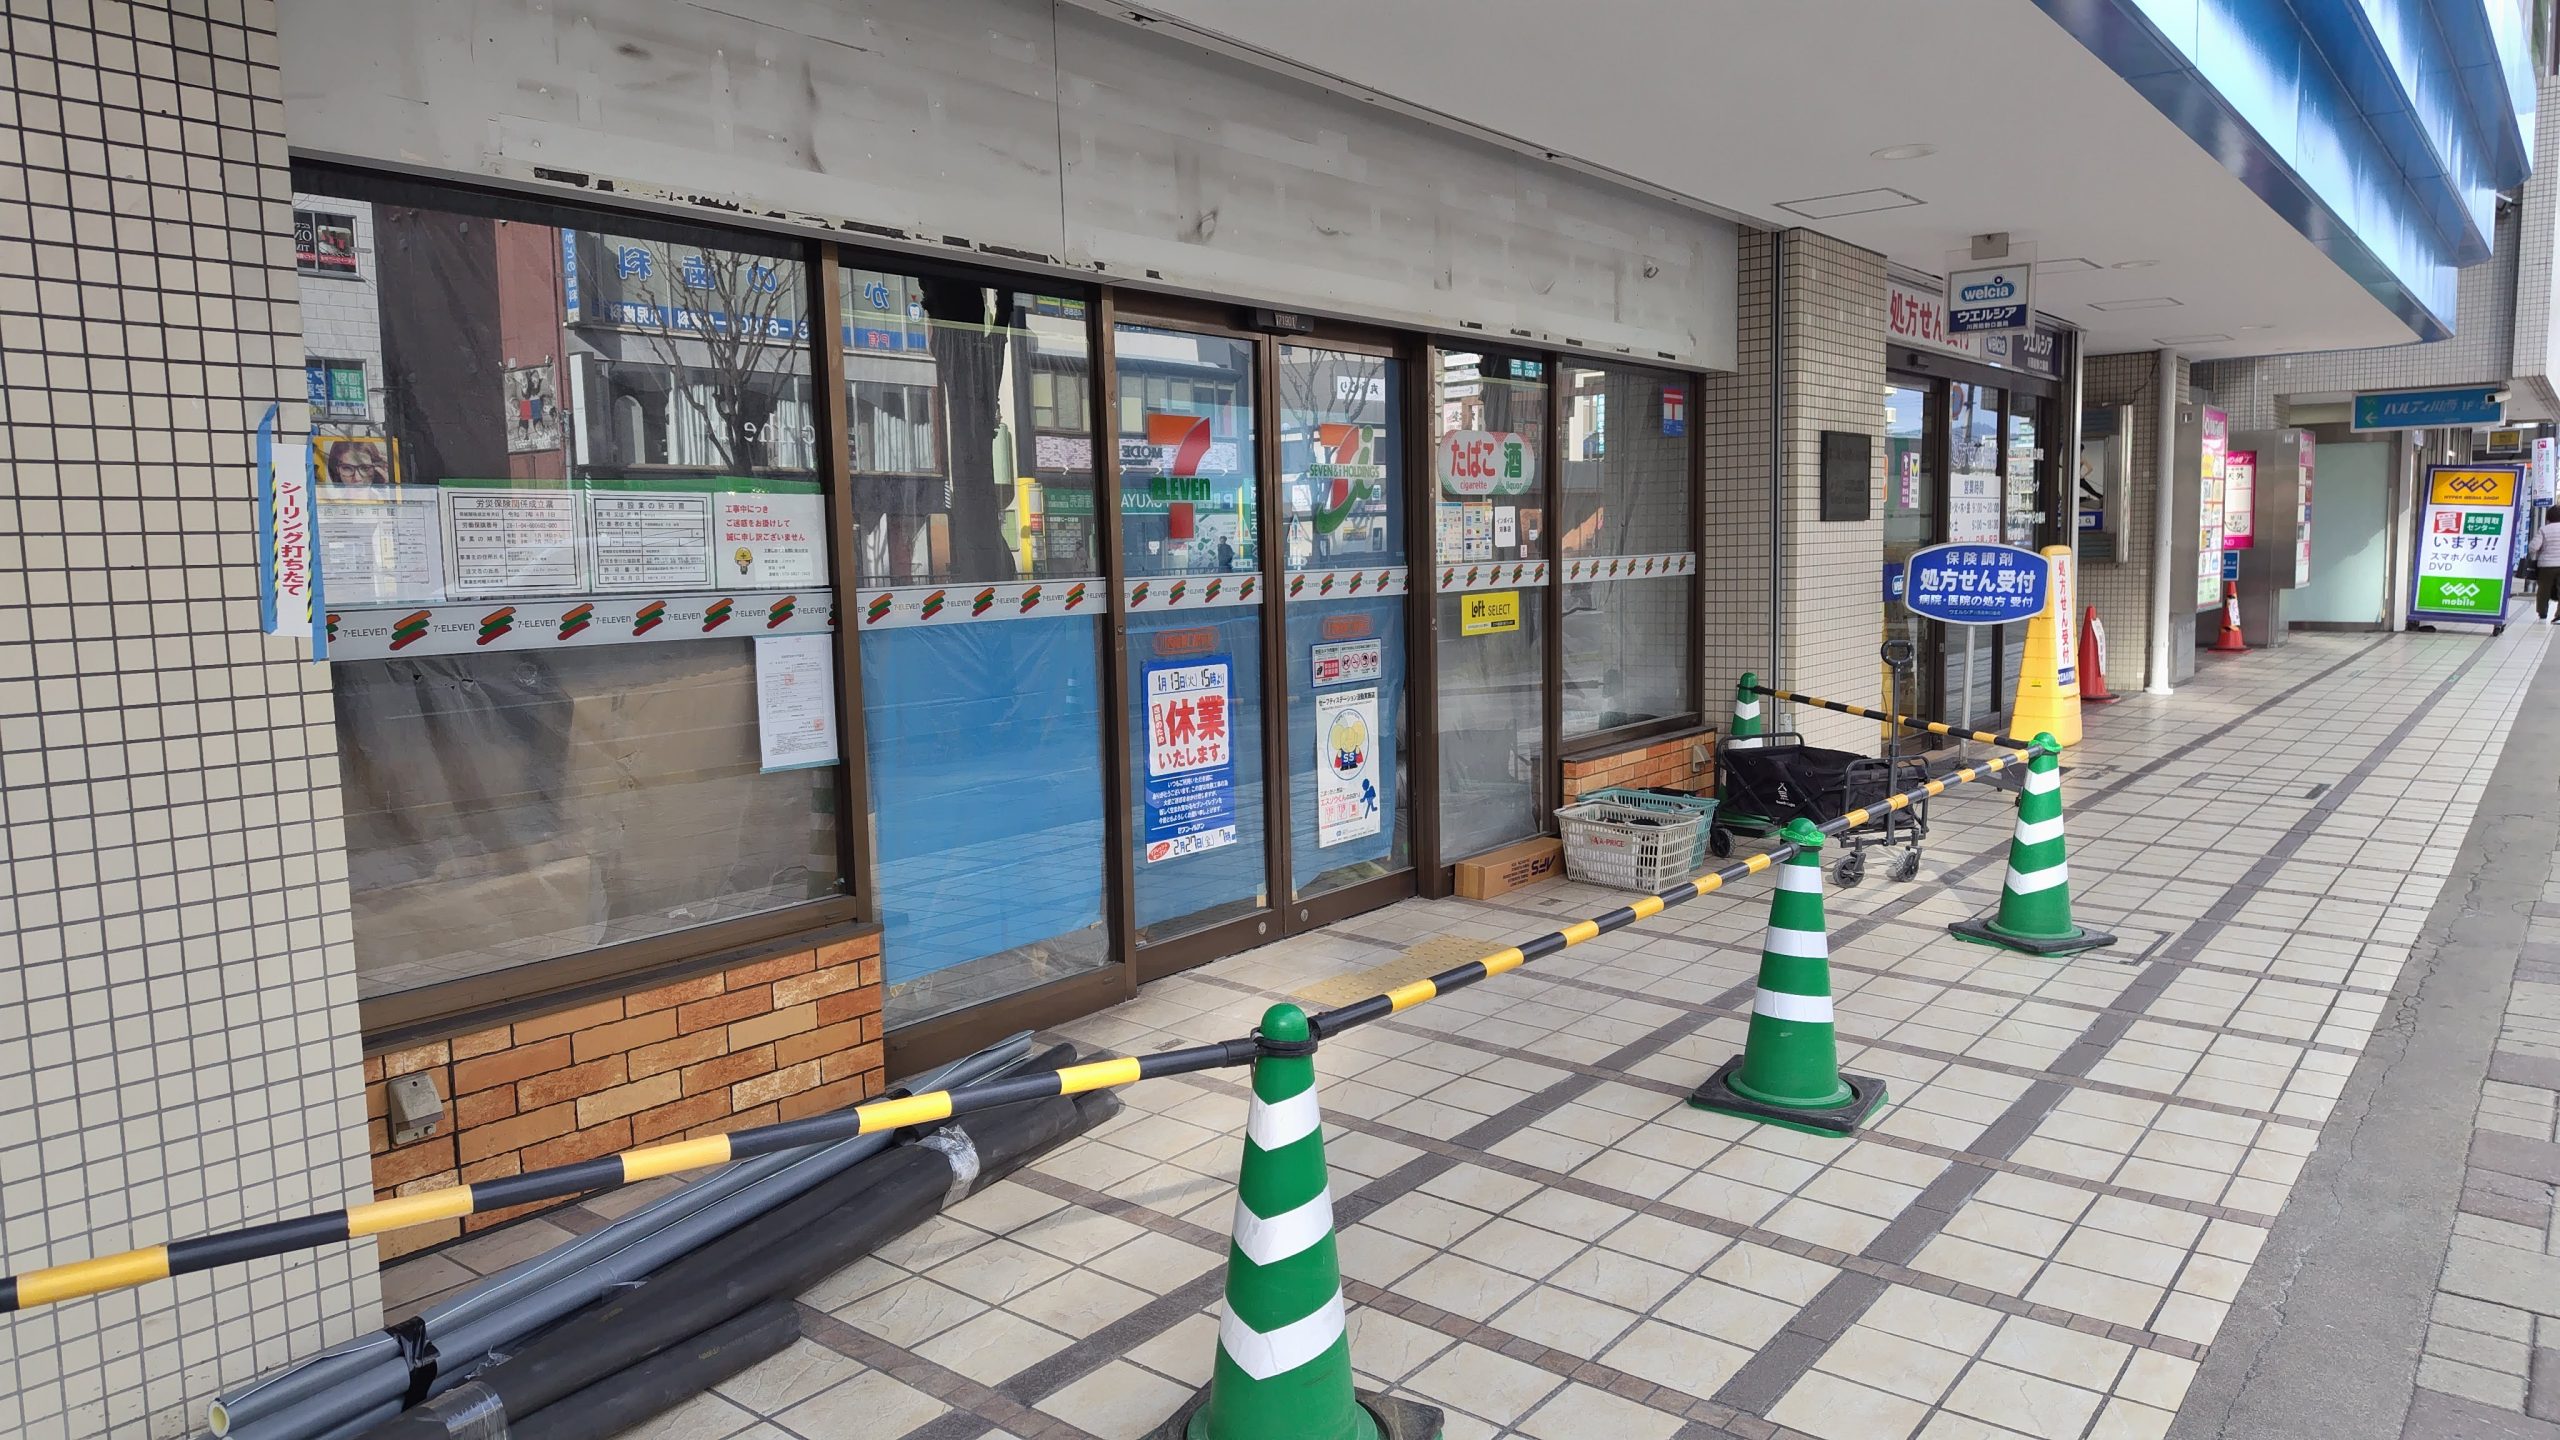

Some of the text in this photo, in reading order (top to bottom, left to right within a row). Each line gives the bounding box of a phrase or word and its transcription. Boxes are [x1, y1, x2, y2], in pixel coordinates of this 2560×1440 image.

[1963, 279, 2010, 301] welcia
[1957, 306, 2017, 323] ウエルシア
[1451, 439, 1496, 478] たばこ
[1503, 441, 1523, 478] 酒
[1460, 480, 1488, 491] cigarette
[2449, 477, 2498, 493] GEO
[725, 504, 769, 514] 工事中につき
[726, 519, 791, 528] ご迷惑をお掛けして
[2436, 512, 2459, 533] 買
[2467, 516, 2500, 524] 高価買取
[281, 481, 305, 596] シーリング打ちたて
[726, 533, 806, 542] 誠に申し訳ございません
[1946, 551, 2014, 566] 保険調剤
[2430, 552, 2498, 564] スマホ/GAME
[2428, 562, 2453, 571] DVD
[1919, 568, 2036, 594] 処方せん受付
[2440, 581, 2480, 597] GEO
[1918, 594, 2034, 608] 病院・医院の処方 受付
[2442, 596, 2476, 607] mobile
[1487, 603, 1511, 617] SELECT
[1165, 695, 1225, 747] 休業
[1159, 743, 1226, 769] いたします。
[1343, 752, 1355, 763] SS
